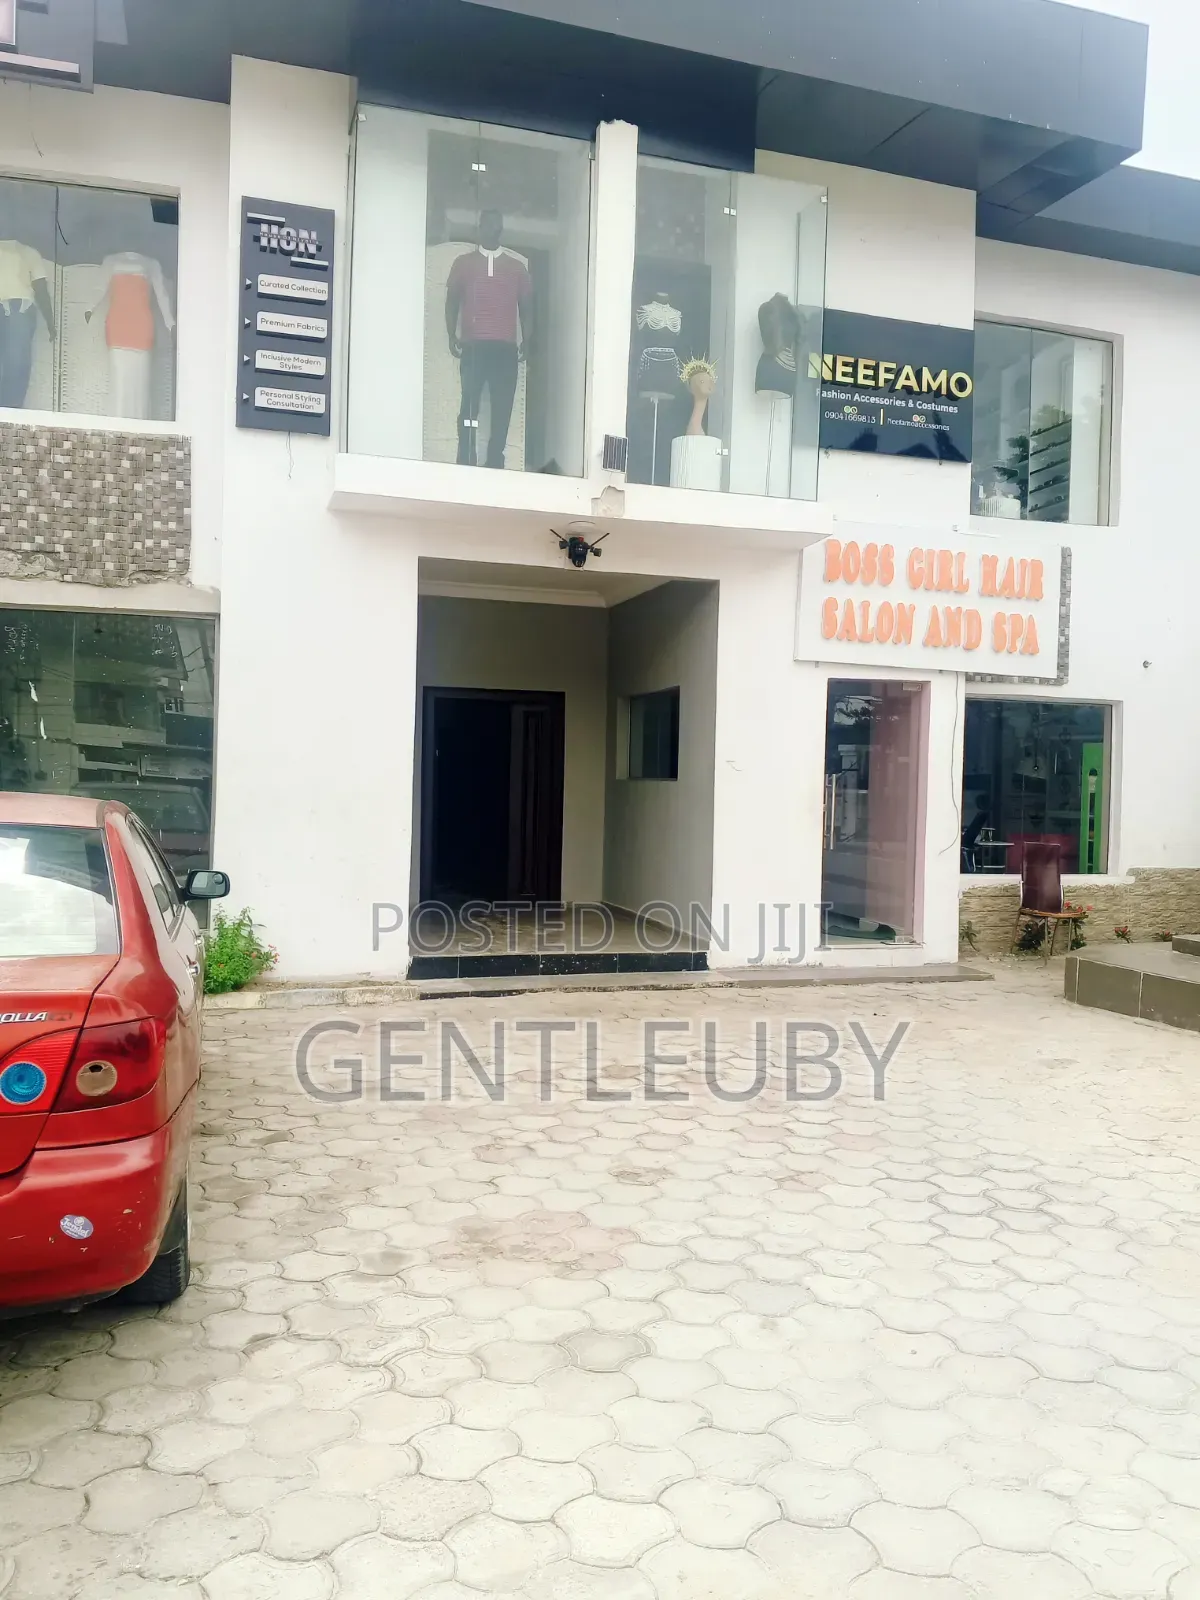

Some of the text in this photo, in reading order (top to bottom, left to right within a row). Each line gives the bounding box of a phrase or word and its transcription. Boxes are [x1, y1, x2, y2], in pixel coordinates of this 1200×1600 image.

[260, 280, 327, 294] Curated Collection
[260, 318, 325, 332] Premium Fabrics
[260, 353, 322, 366] Inclusive Modern
[280, 362, 303, 371] Styles
[807, 352, 973, 398] NEEFAMO
[260, 390, 321, 405] Personal Styling
[266, 398, 314, 410] Consultation
[816, 388, 958, 413] Fashion Accessories & Costumes
[823, 539, 1043, 601] BOSS GIRL HAIR
[821, 597, 1040, 655] SALON AND SPA
[0, 1011, 48, 1023] OLLA
